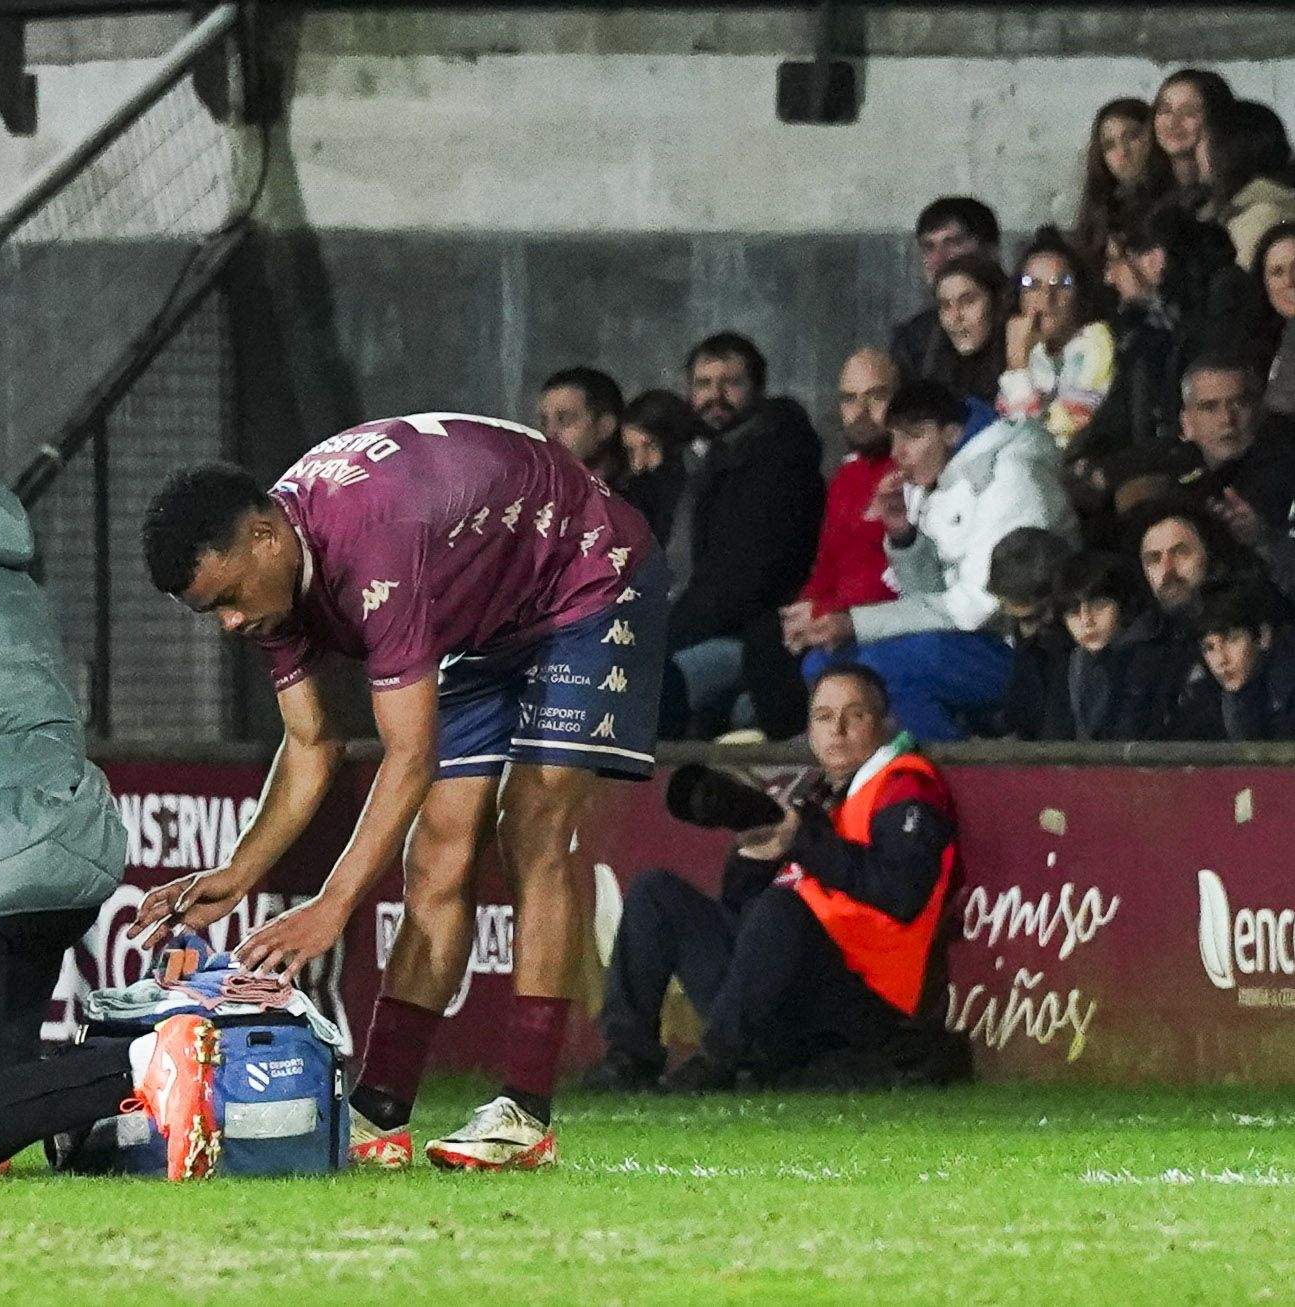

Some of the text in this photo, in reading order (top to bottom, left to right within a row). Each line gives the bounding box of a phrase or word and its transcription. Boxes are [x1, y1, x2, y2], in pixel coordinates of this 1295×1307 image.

[550, 673, 591, 686] GALICIA
[539, 707, 586, 721] DEPORTE
[537, 719, 581, 733] GALEGO
